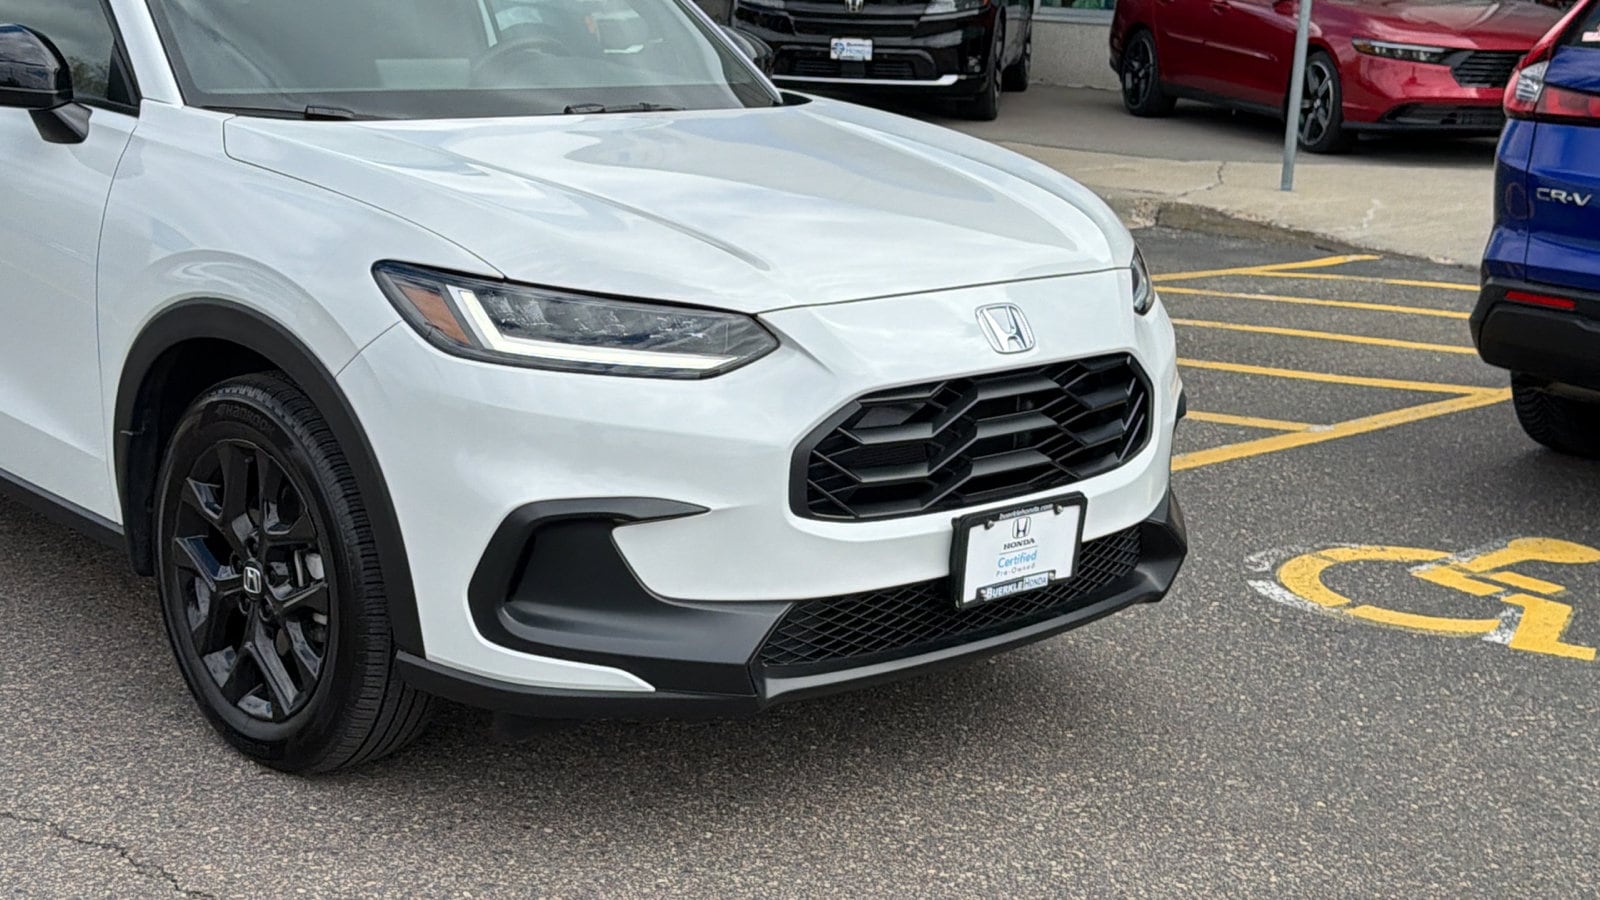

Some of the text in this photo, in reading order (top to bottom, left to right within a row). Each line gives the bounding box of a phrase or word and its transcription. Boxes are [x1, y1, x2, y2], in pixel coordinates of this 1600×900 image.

[1003, 537, 1036, 550] HONDA
[997, 550, 1038, 568] Certified
[996, 562, 1035, 577] Pre-Owned
[986, 575, 1047, 600] BUERKLE HONDA
